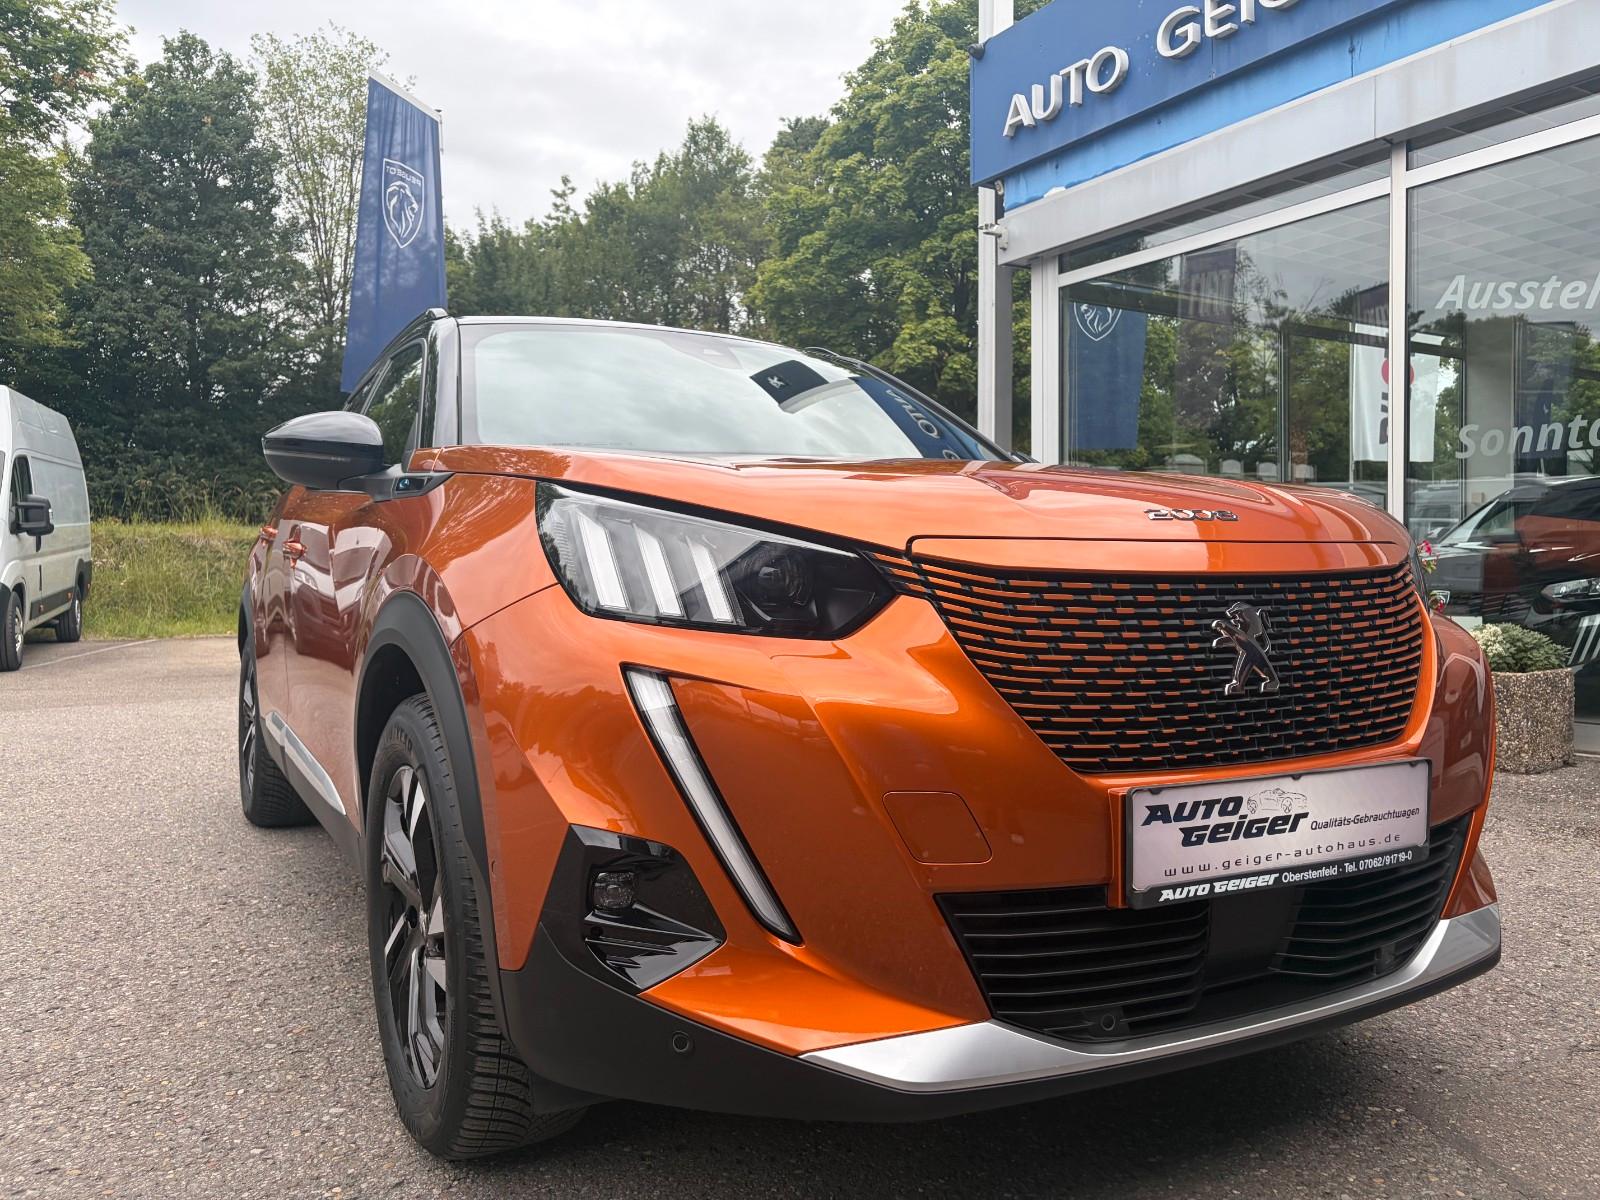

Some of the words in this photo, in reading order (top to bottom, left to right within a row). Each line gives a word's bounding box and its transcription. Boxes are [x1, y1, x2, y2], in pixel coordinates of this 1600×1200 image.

[1003, 46, 1129, 137] AUTO
[1435, 272, 1600, 310] Ausstel
[1144, 509, 1239, 521] 2008
[1141, 796, 1244, 826] AUTO
[1310, 807, 1420, 831] Qualitäts-Gebrauchtwagen
[1164, 834, 1401, 877] www.geiger-autohaus.de
[1159, 883, 1211, 902] AUTO
[1282, 865, 1338, 883] Oberstenfeld
[1344, 862, 1357, 873] Tel.
[1360, 850, 1413, 871] 07062/91719-0
